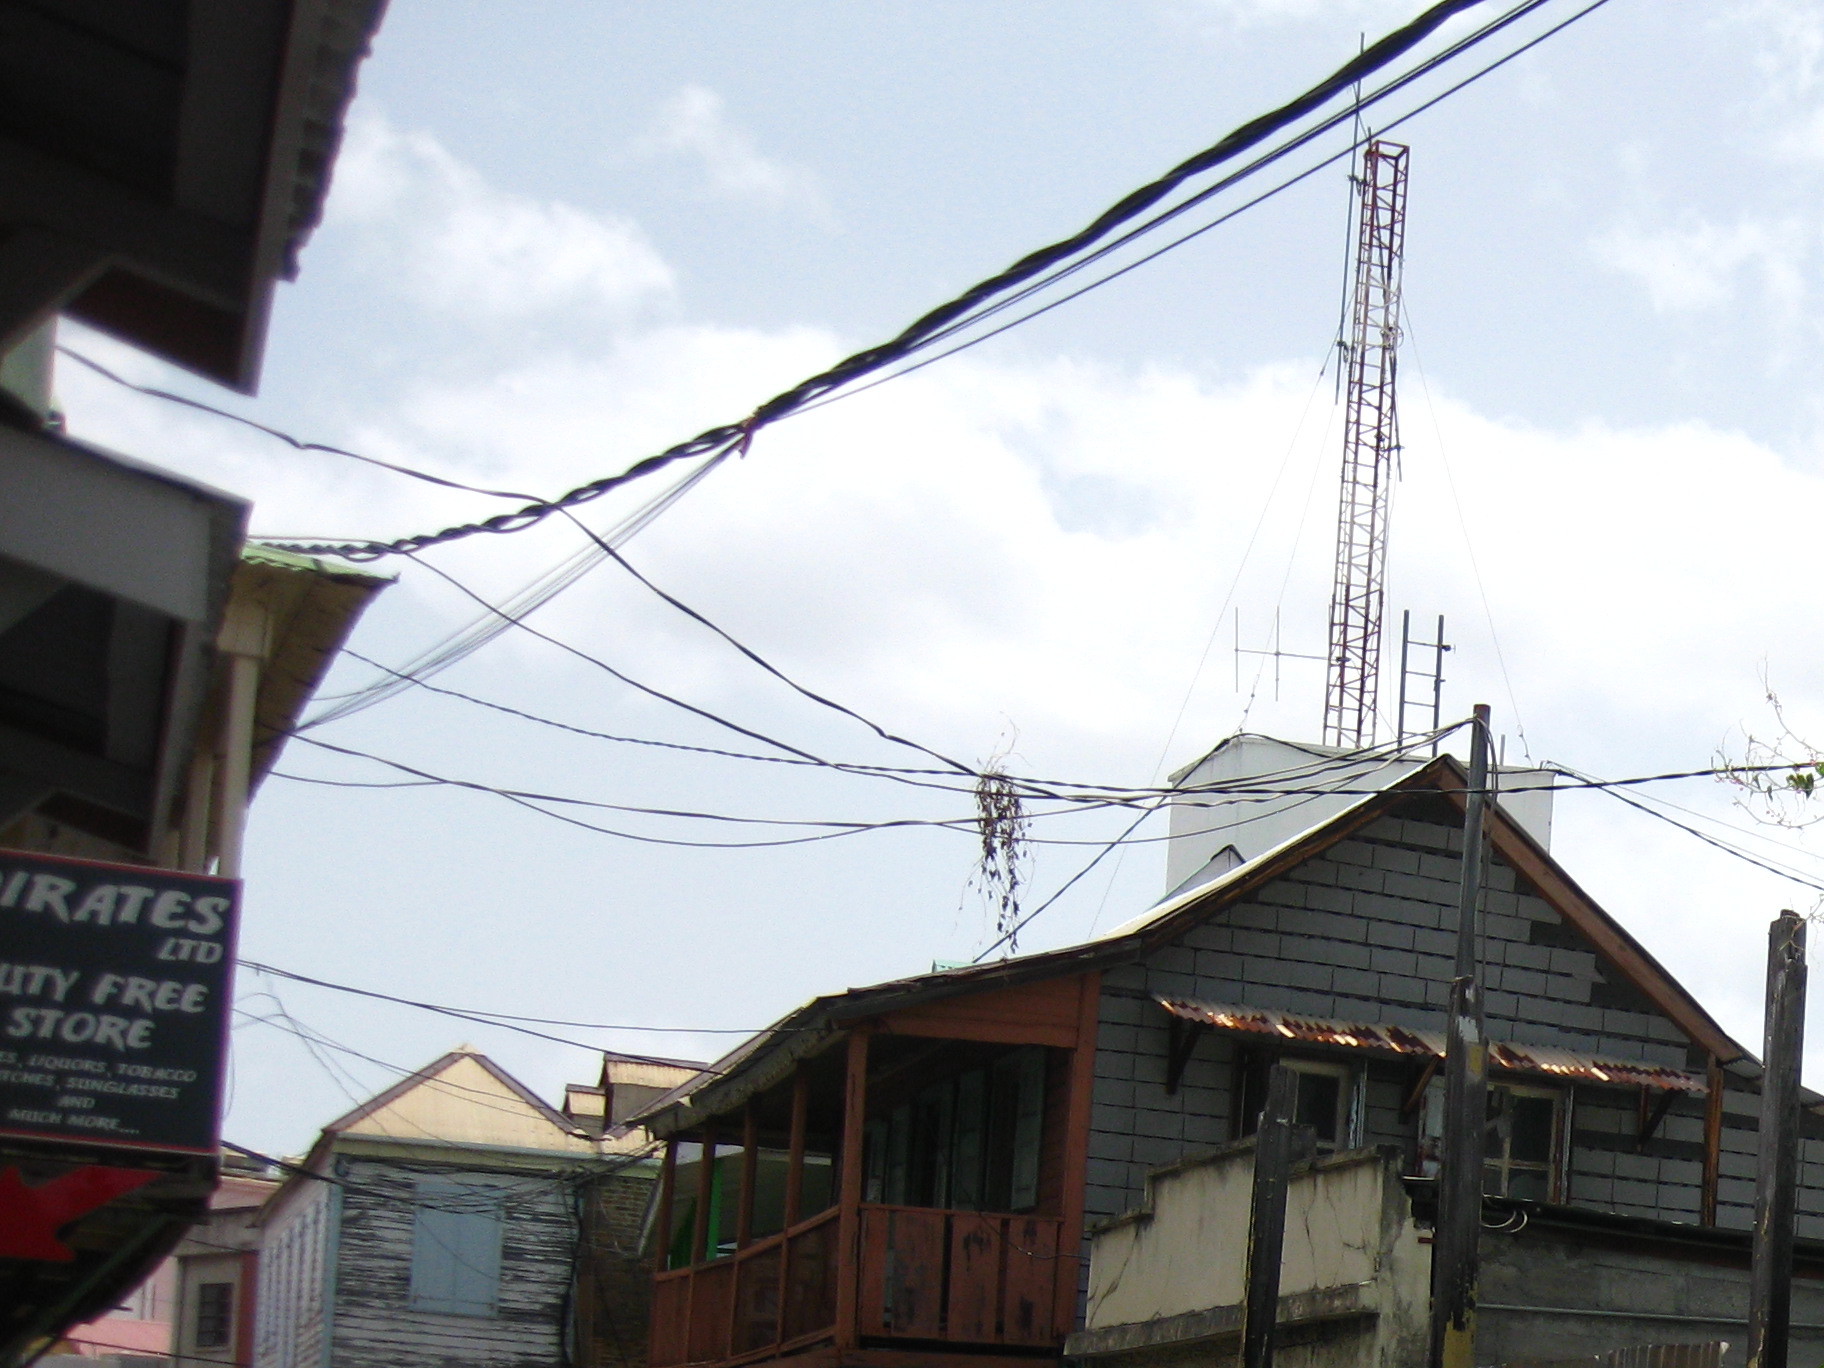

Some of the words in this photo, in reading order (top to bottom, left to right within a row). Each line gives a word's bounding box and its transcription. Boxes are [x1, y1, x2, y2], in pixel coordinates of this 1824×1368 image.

[0, 870, 231, 935] IRATES
[157, 937, 224, 964] LTD
[0, 963, 80, 1002] UTY
[92, 973, 209, 1014] FREE
[6, 1007, 156, 1051] STORE
[117, 1063, 197, 1082] TOBACCO
[65, 1077, 181, 1099] SUNGLASSES
[56, 1095, 96, 1109] AND
[8, 1108, 63, 1124] MUCH
